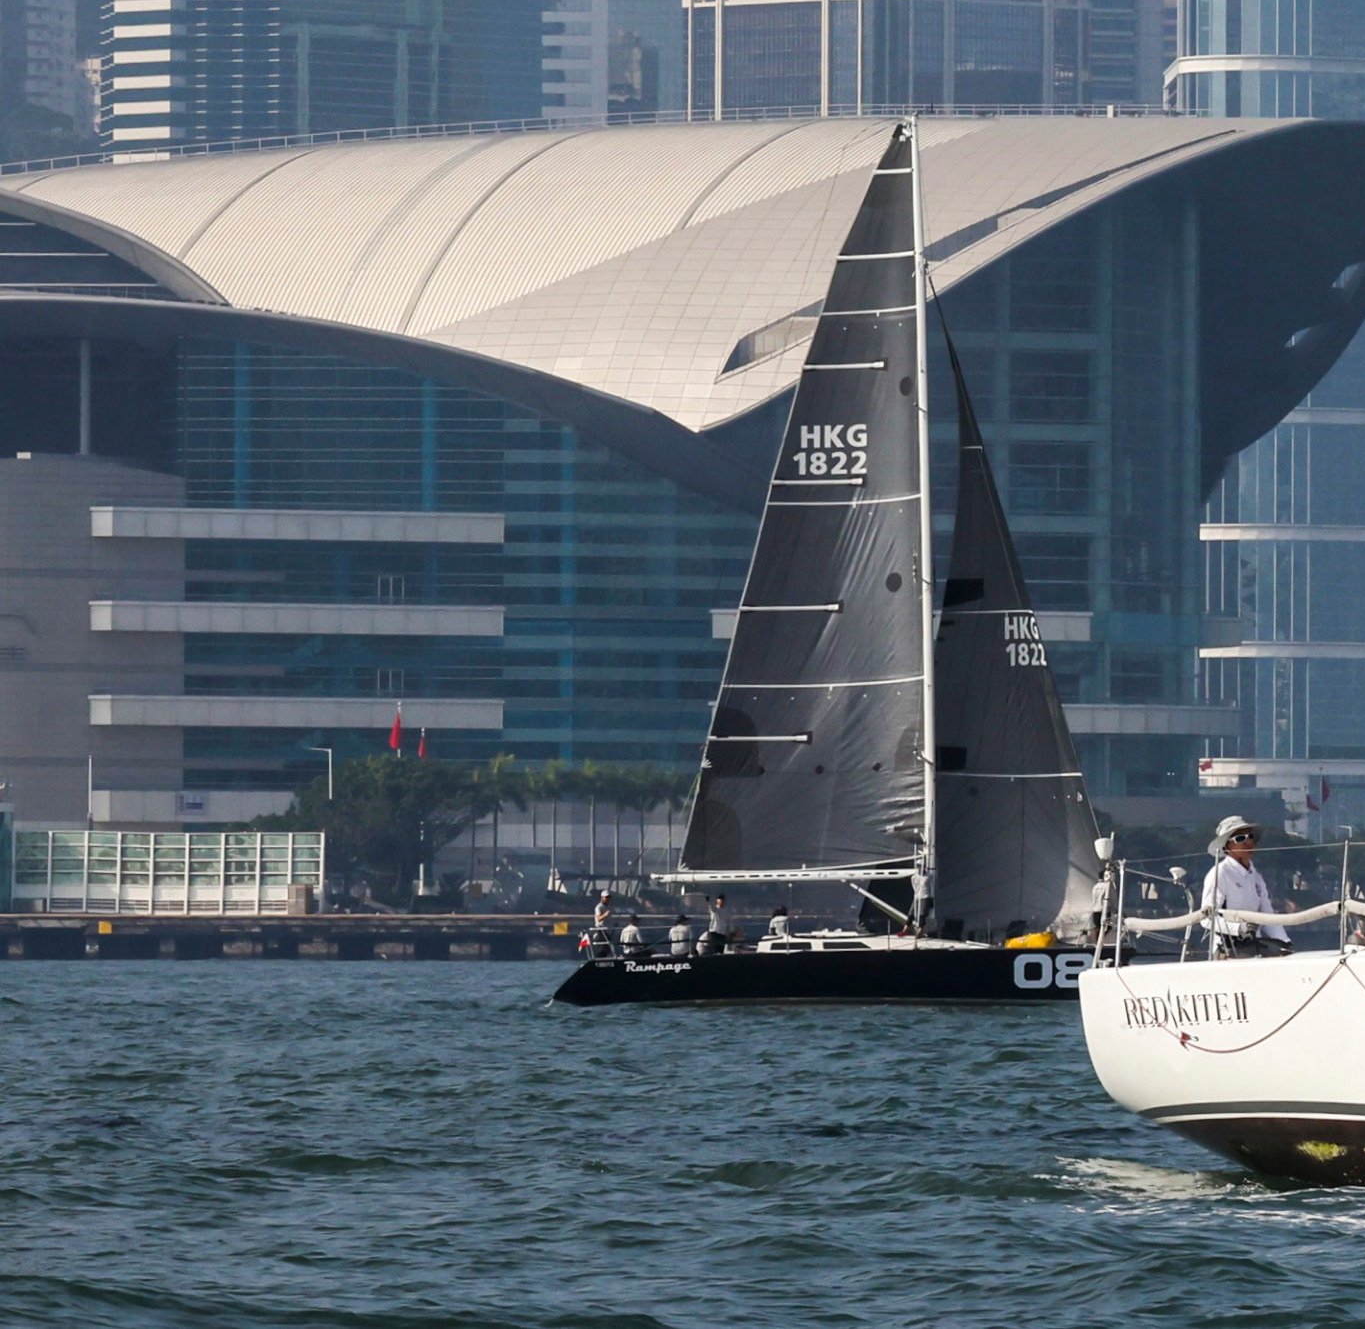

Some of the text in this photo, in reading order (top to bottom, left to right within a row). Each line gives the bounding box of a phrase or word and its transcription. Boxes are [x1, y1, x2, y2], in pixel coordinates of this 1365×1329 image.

[801, 424, 867, 448] HKG
[793, 451, 867, 475] 1822
[1005, 616, 1039, 640] HKG
[1005, 643, 1047, 666] 1822
[624, 961, 692, 974] Rampage
[1014, 953, 1094, 988] 08
[1123, 997, 1168, 1028] RED
[1176, 993, 1231, 1025] KITE
